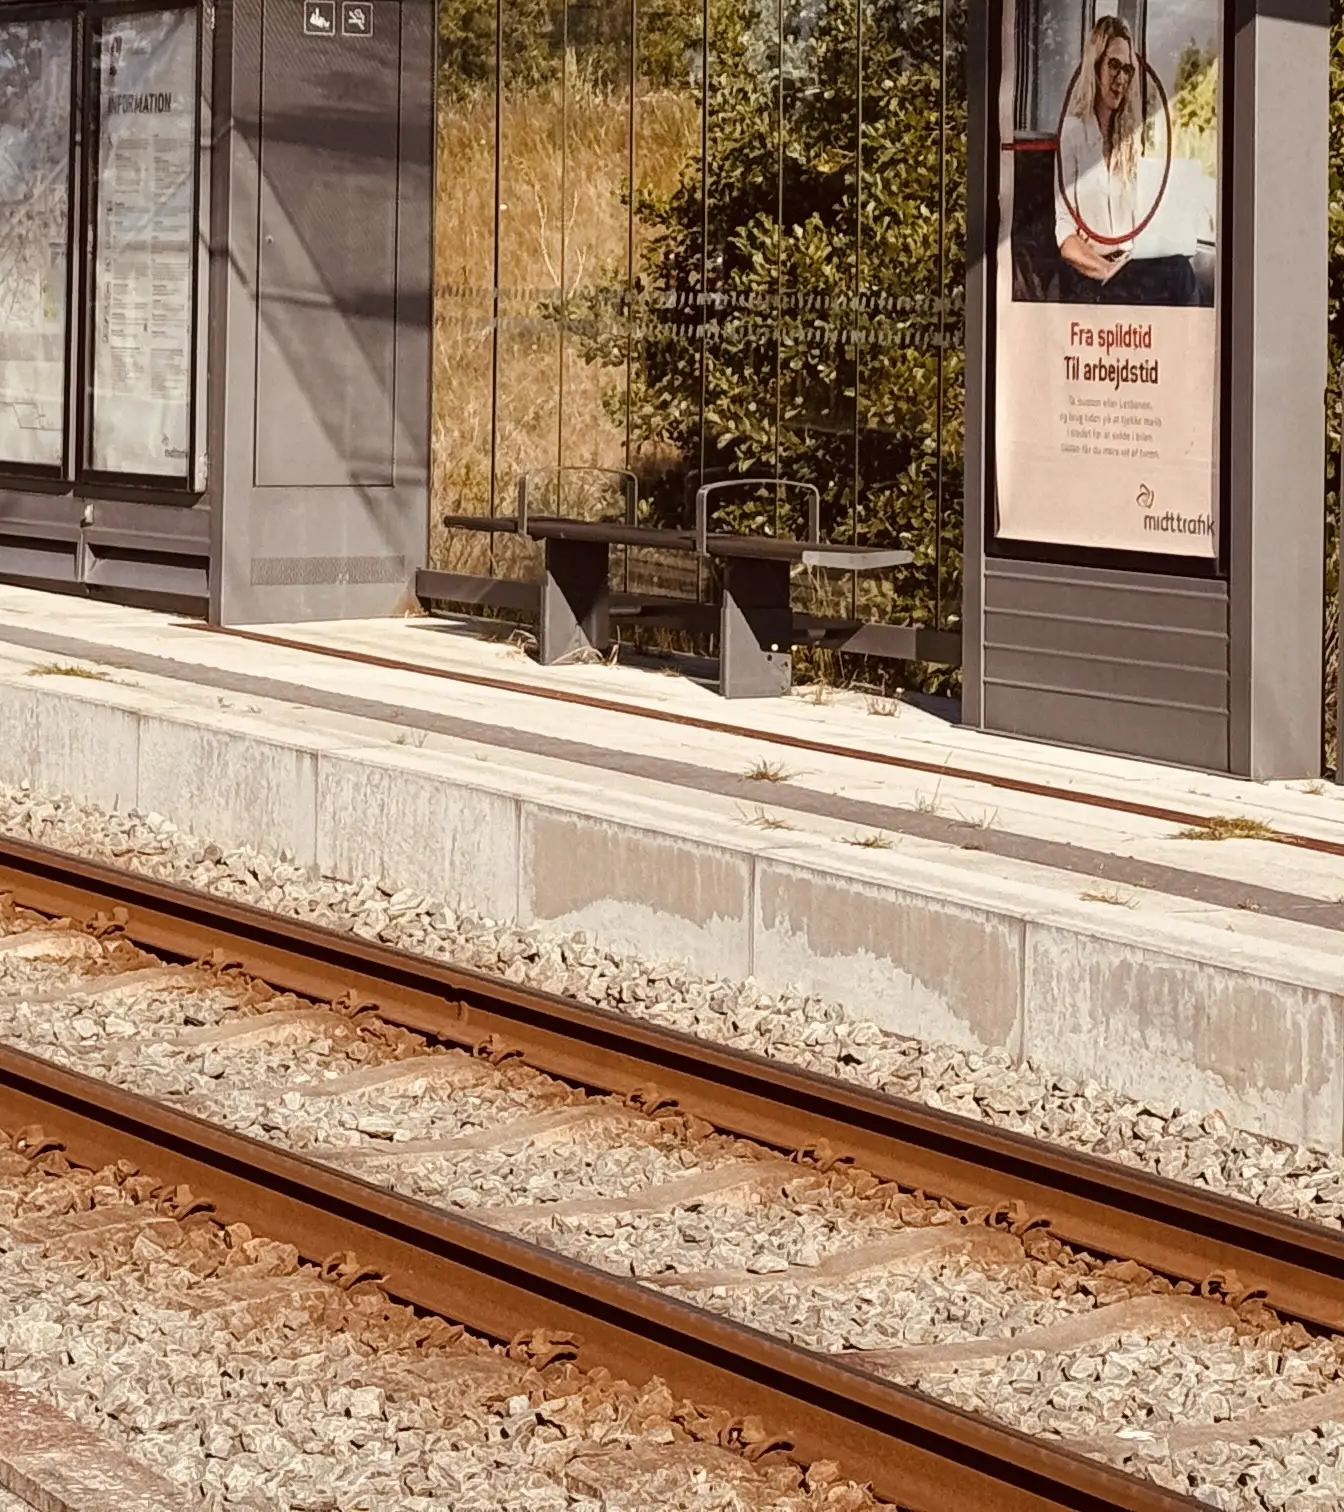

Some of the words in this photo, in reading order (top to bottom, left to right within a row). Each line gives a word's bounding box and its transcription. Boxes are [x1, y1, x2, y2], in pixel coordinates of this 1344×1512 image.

[108, 92, 172, 113] INFORMATION
[1071, 322, 1094, 347] Fra
[1098, 323, 1152, 355] spildtid
[1064, 356, 1079, 380] Til
[1084, 358, 1158, 390] arbejdstid
[1144, 511, 1215, 536] midttrafik
